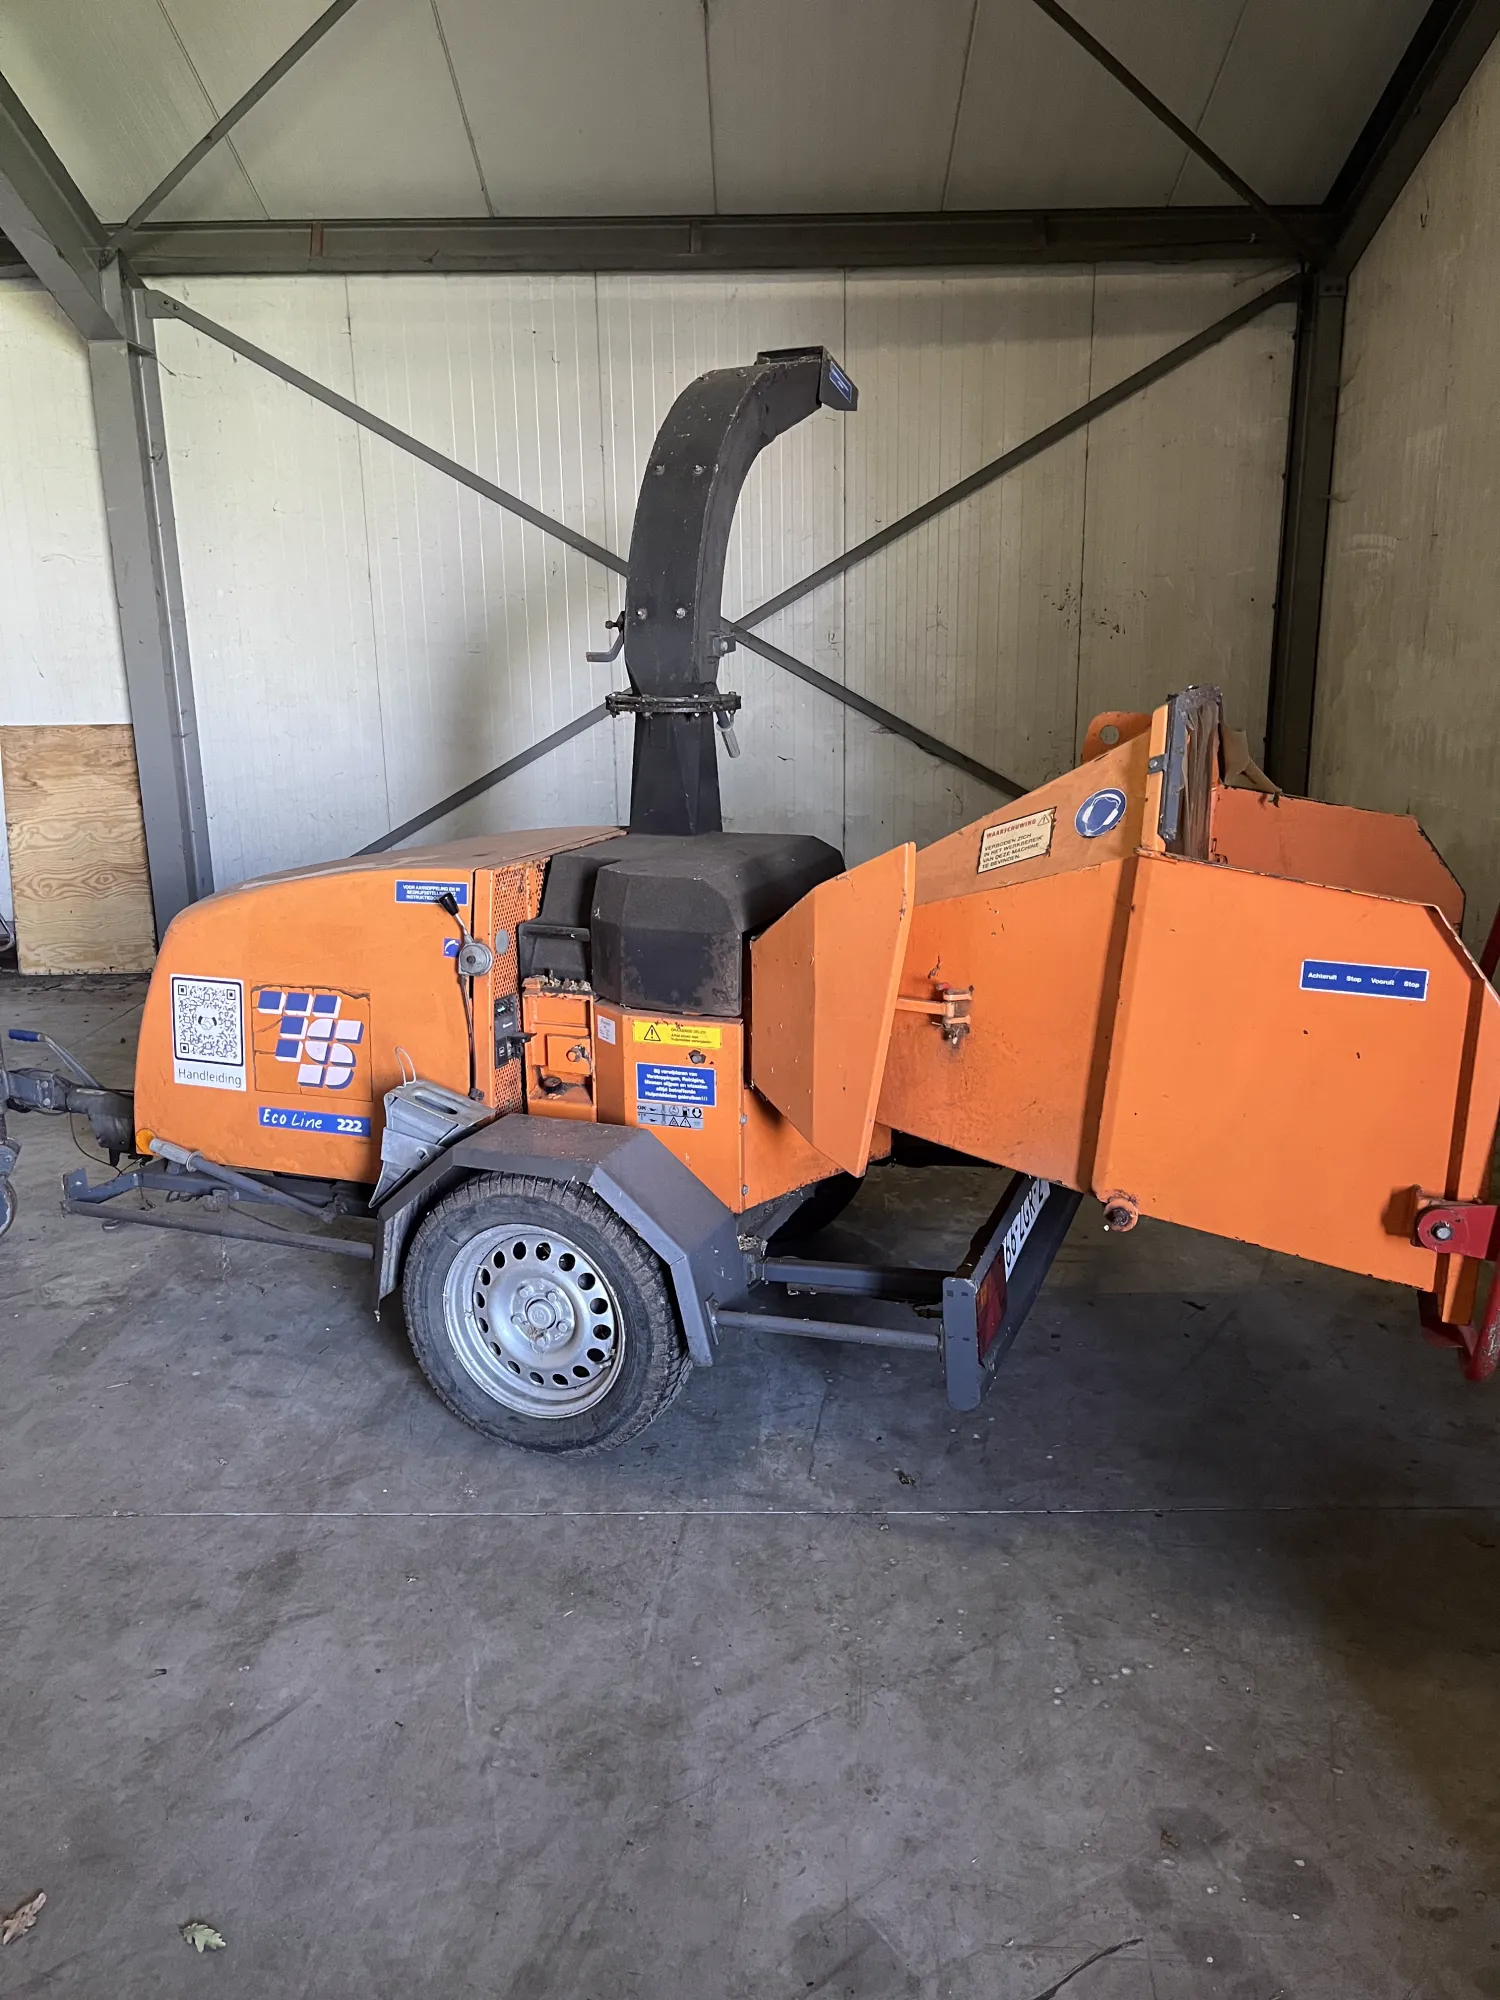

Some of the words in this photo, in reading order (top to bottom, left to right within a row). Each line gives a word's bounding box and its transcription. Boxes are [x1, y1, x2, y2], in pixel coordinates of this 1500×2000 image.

[986, 819, 1037, 839] WAARSCHUWING
[984, 838, 1016, 851] VERBODEN
[1017, 834, 1032, 842] ZICH
[995, 851, 1011, 859] DEZE
[1012, 843, 1039, 854] MACHINE
[1003, 835, 1044, 851] WERKBEREIK
[1308, 972, 1337, 980] Achteruit
[178, 1068, 242, 1088] Handleiding
[262, 1108, 287, 1125] Eco
[291, 1112, 323, 1129] Line
[336, 1118, 363, 1132] 222
